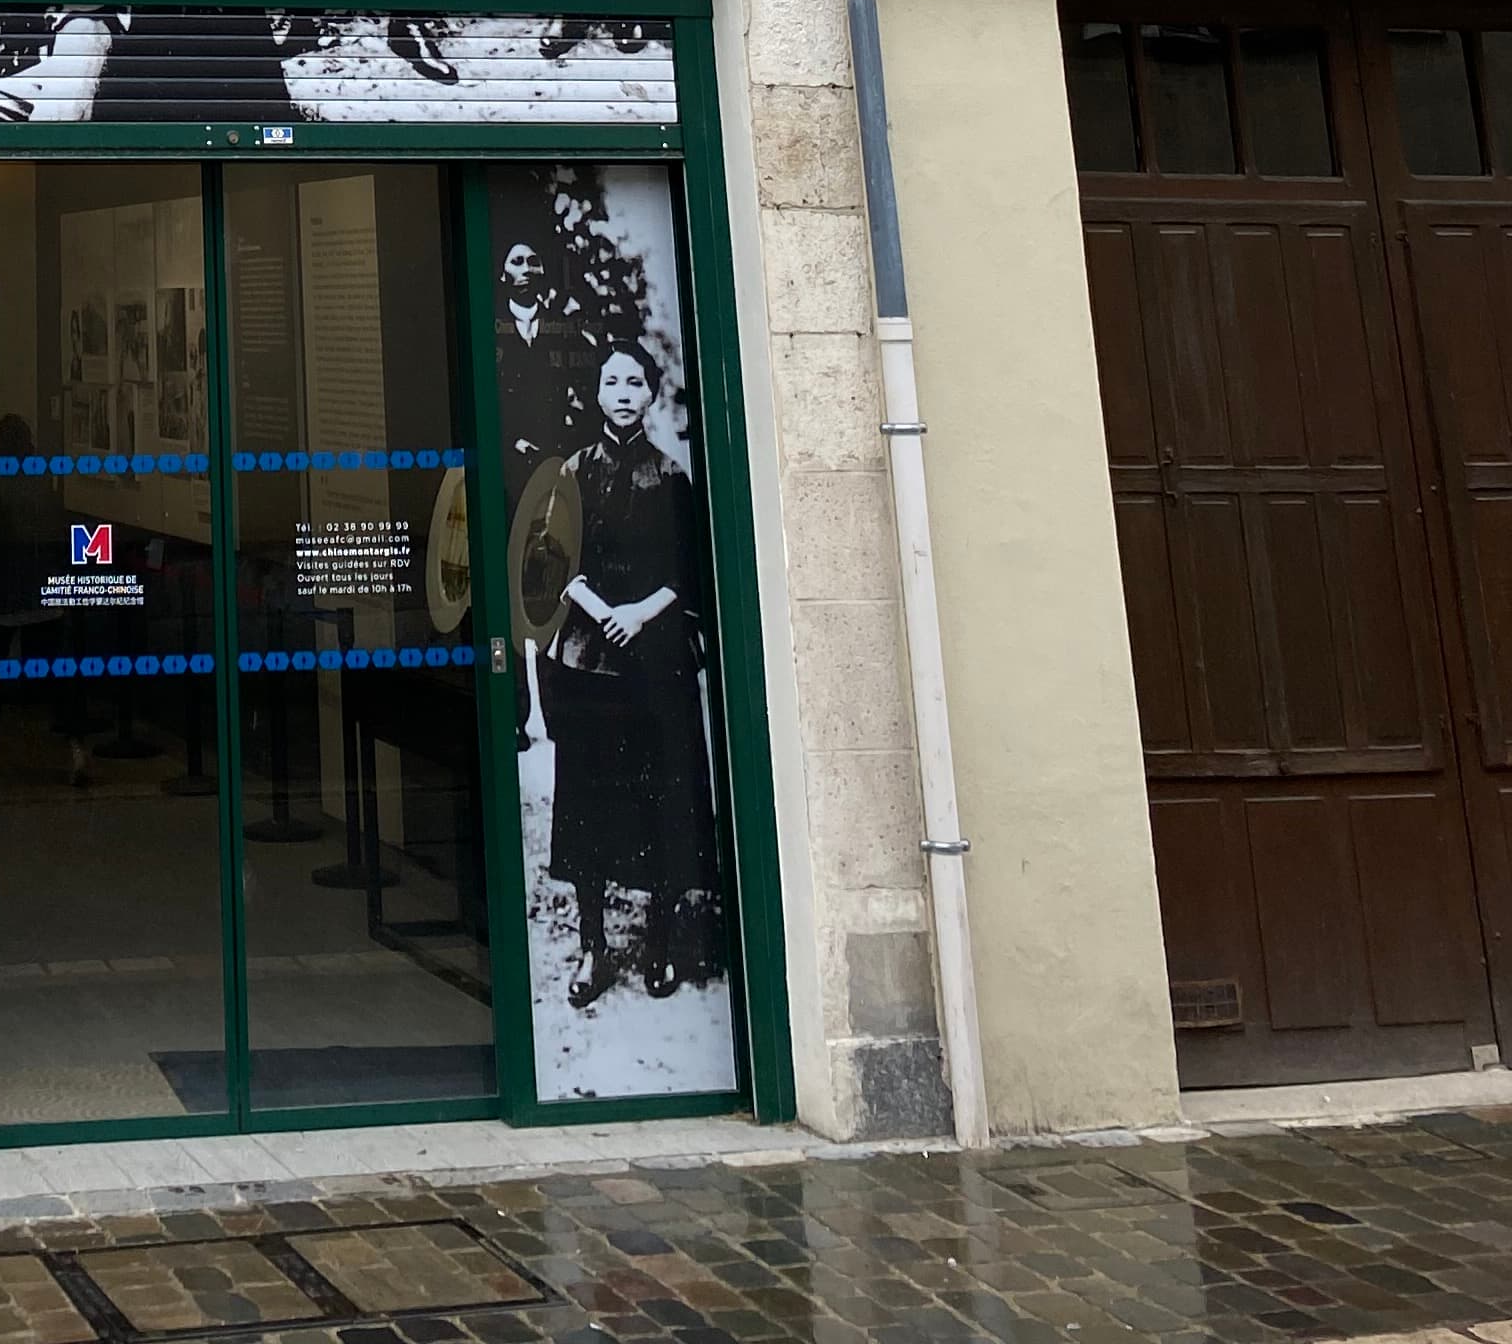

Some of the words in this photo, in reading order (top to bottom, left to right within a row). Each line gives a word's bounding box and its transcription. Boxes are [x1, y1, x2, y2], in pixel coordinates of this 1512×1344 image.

[326, 522, 340, 532] 02
[296, 560, 329, 570] Visites
[331, 559, 369, 570] guidées
[372, 559, 387, 568] sur
[390, 558, 411, 568] RDV
[47, 573, 76, 585] MUSÉE
[77, 575, 125, 585] HISTORIQUE
[125, 575, 137, 584] DE
[297, 573, 329, 583] Ouvert
[331, 573, 352, 582] tous
[354, 572, 368, 582] les
[370, 572, 394, 583] jours
[73, 585, 144, 595] FRANCO-CHINOISE
[297, 585, 317, 595] sauf
[319, 585, 328, 594] le
[329, 584, 356, 594] mardi
[357, 584, 369, 594] de
